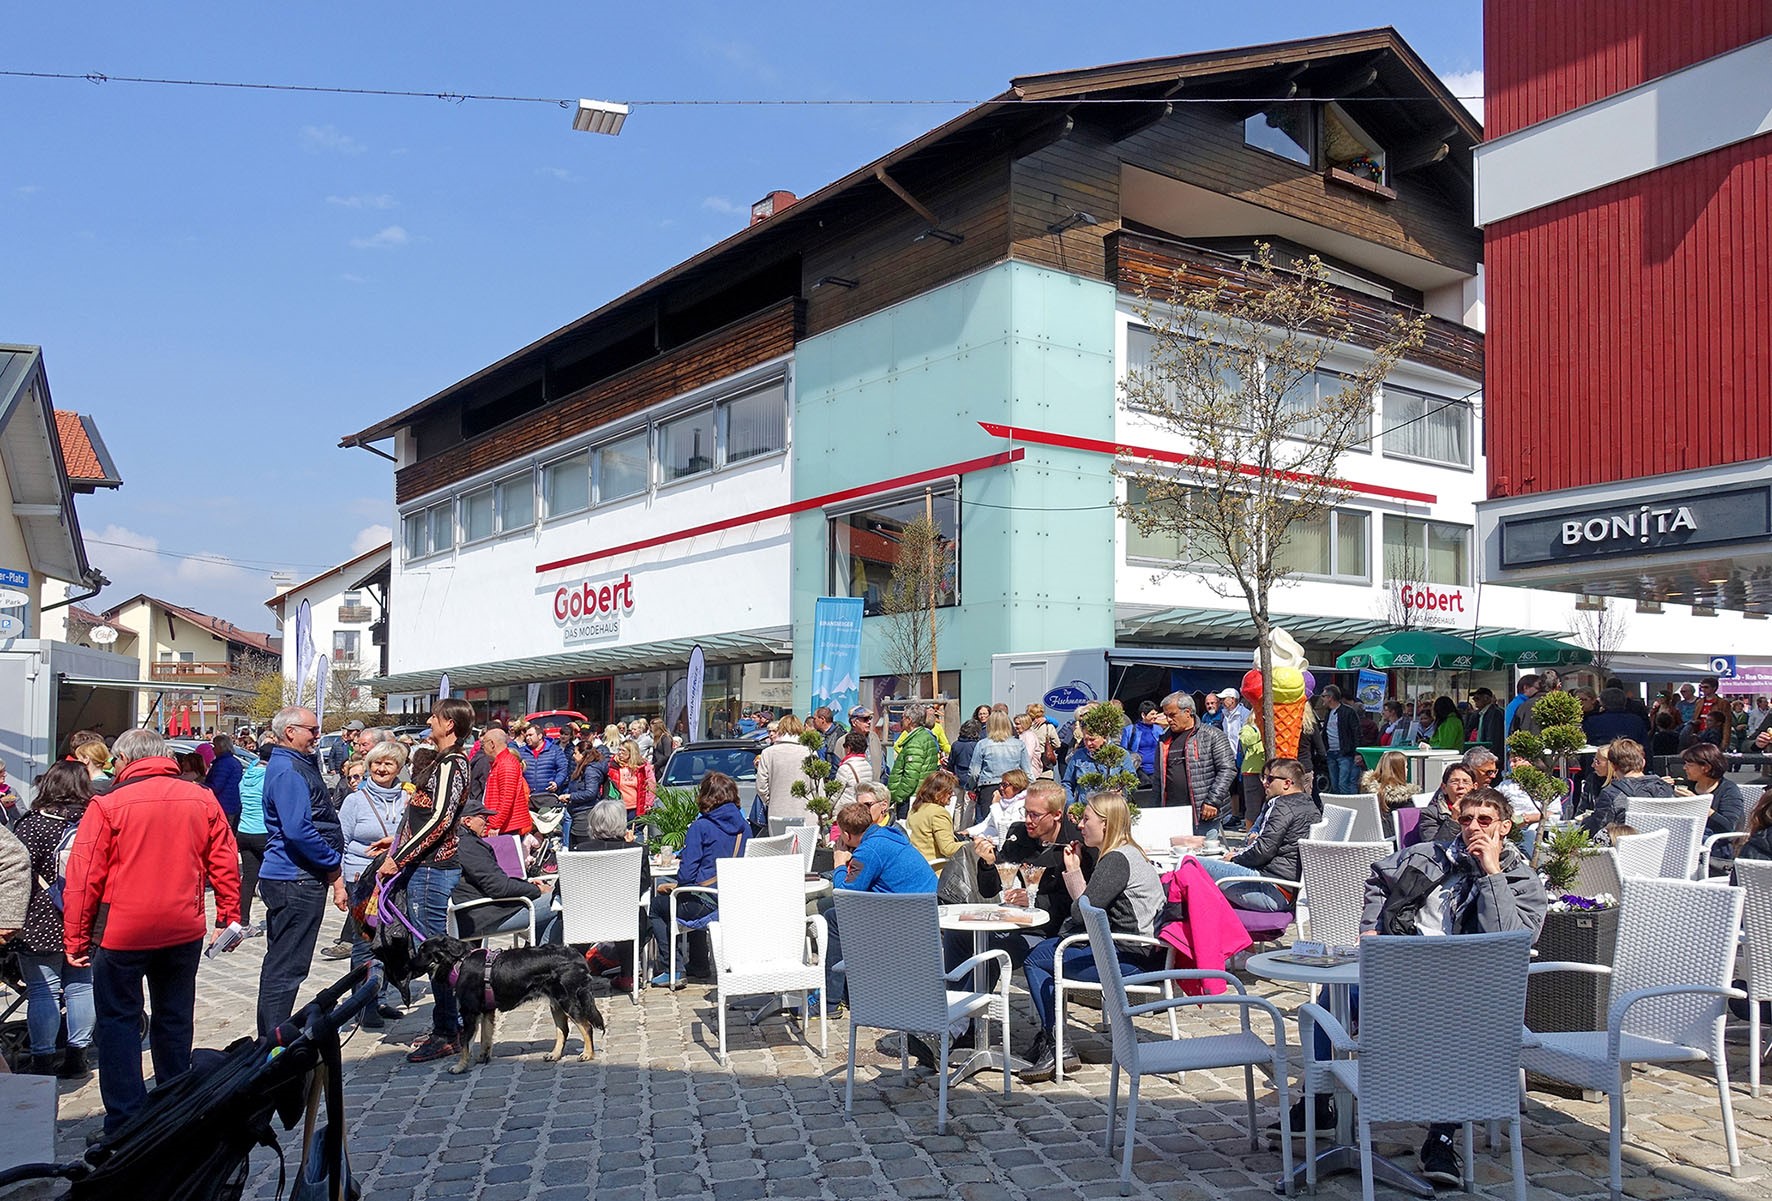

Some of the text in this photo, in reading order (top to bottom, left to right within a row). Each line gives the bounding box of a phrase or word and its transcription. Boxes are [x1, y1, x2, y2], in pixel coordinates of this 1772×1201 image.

[554, 574, 634, 620] Gobert
[1401, 585, 1465, 613] Gobert
[565, 622, 619, 640] DAS MODEHAUS
[1393, 653, 1416, 663] AOK
[1452, 655, 1473, 665] AOK
[1518, 650, 1539, 660] AOK
